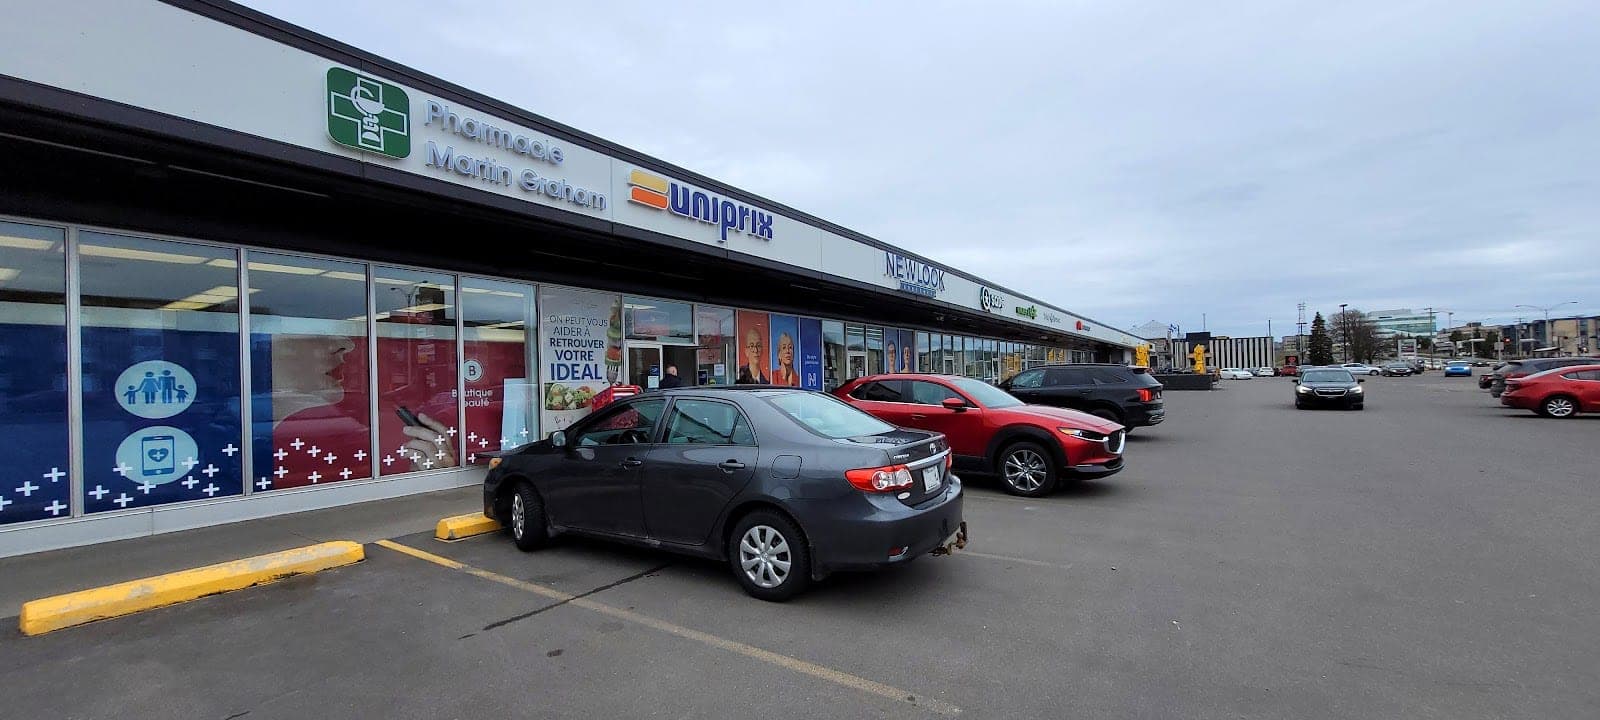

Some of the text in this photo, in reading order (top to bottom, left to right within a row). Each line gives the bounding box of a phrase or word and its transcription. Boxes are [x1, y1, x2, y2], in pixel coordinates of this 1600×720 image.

[424, 100, 565, 167] Pharmacie
[425, 140, 607, 211] Martin Graham
[549, 314, 609, 328] ON PEUT VOUS
[553, 326, 582, 337] AIDER
[549, 337, 605, 349] RETROUVER
[555, 349, 594, 361] VOTRE
[469, 365, 476, 376] B
[550, 363, 603, 381] IDEAL
[451, 389, 493, 399] Butique
